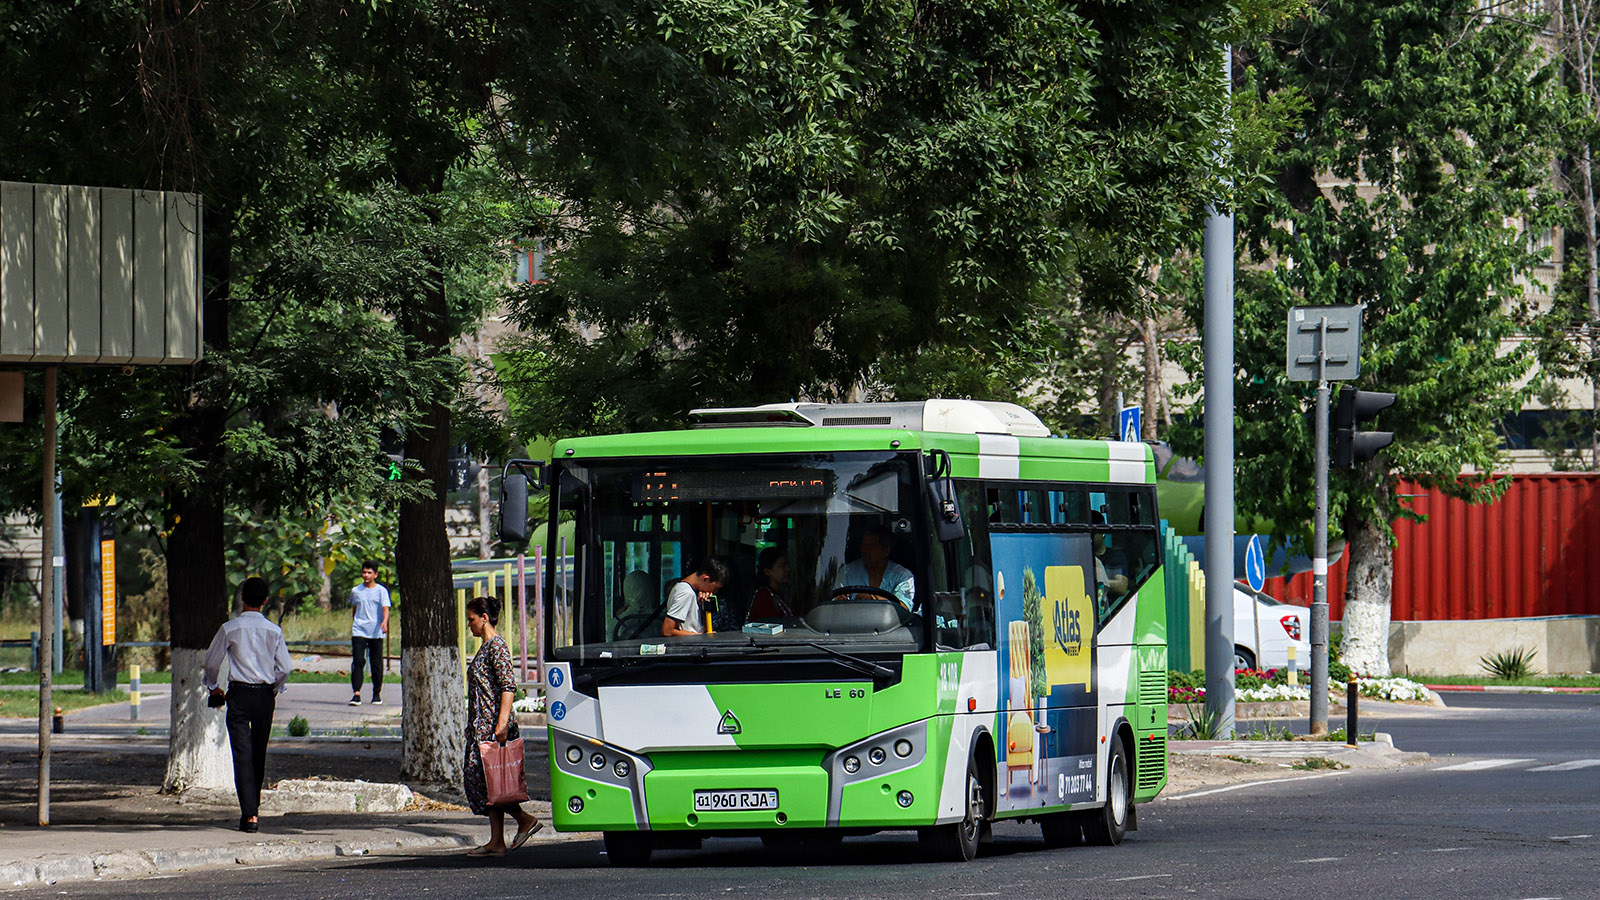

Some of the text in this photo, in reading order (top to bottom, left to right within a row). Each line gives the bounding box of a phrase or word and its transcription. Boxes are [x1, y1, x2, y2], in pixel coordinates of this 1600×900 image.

[1053, 597, 1081, 643] Atlas
[825, 688, 865, 699] LE 60
[698, 793, 769, 807] 01 960 RJA
